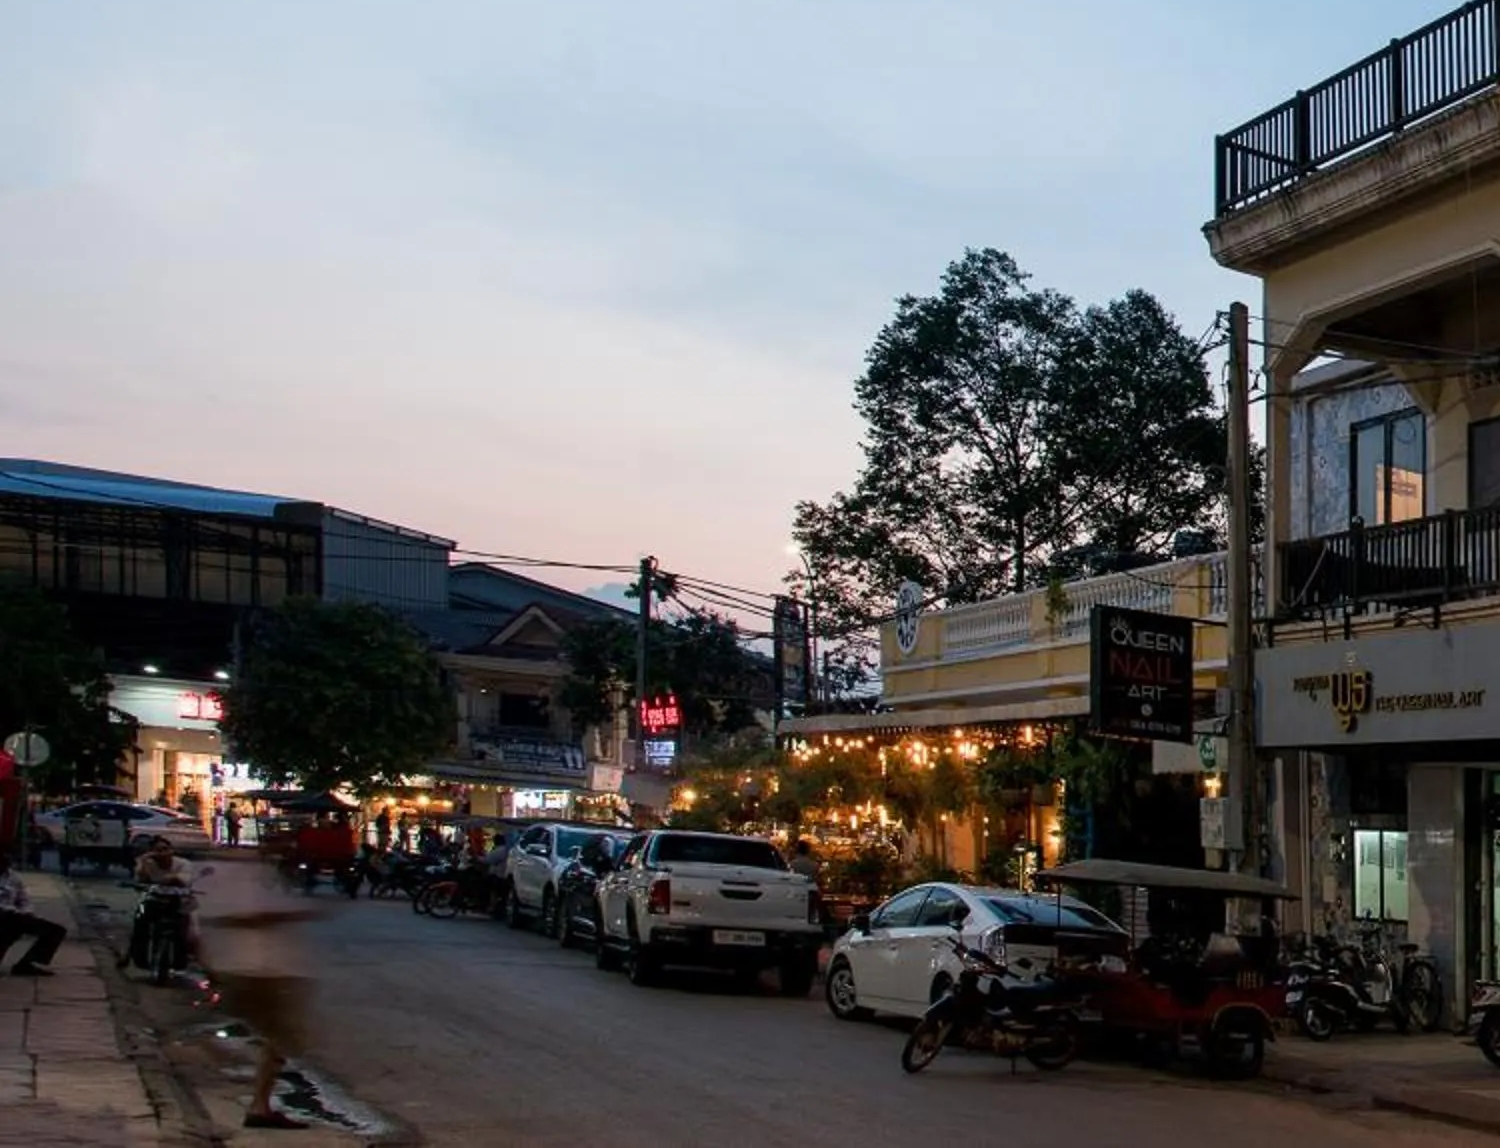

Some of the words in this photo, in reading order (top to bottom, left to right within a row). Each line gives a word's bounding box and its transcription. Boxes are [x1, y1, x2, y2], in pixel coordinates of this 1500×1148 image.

[1109, 626, 1186, 655] QUEEN
[1109, 651, 1184, 684] NAIL
[1127, 684, 1169, 702] ART
